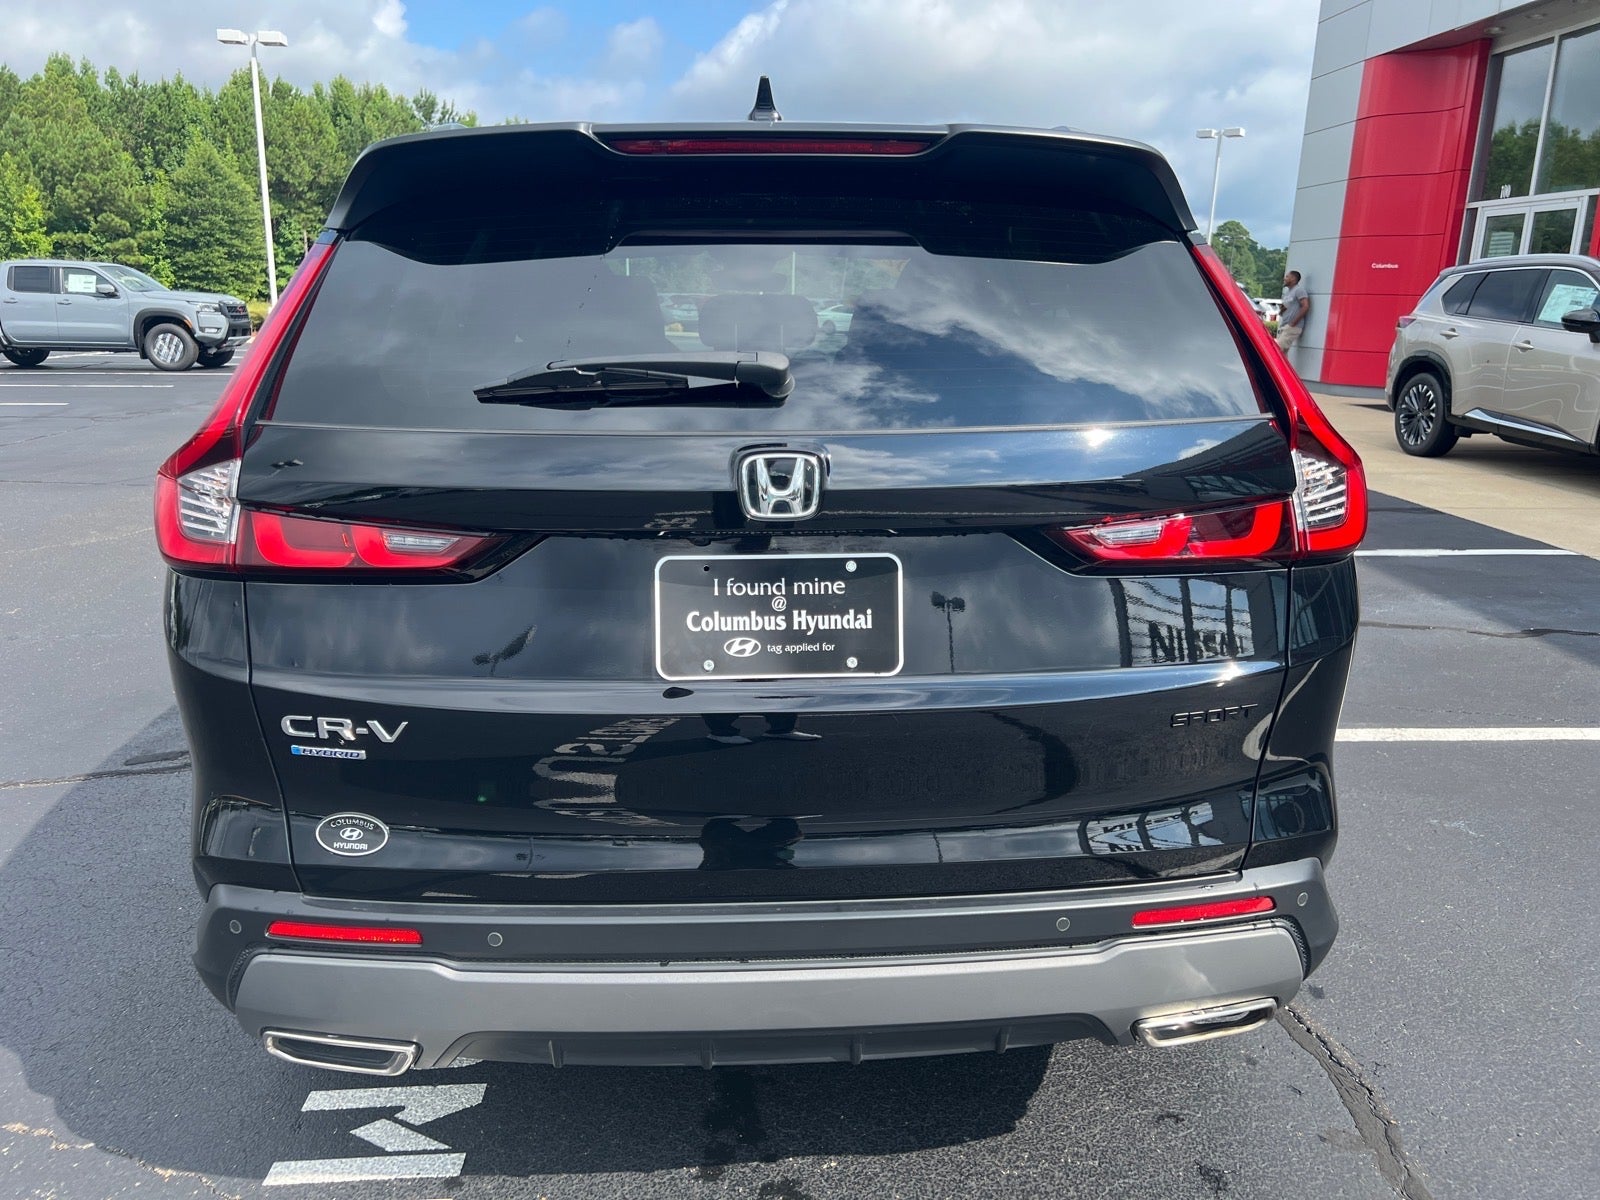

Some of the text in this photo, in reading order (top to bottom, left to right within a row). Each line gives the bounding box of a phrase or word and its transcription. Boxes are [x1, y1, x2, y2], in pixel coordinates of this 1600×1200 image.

[713, 577, 846, 596] I found mine
[771, 595, 787, 612] @
[686, 609, 873, 635] Columbus Hyundai
[767, 642, 836, 654] tag applied for
[1170, 703, 1259, 728] SPORT
[280, 715, 409, 743] CR-V
[302, 748, 361, 759] HYBRID
[330, 818, 375, 831] COLUMBUS
[333, 842, 368, 850] HYUNDAI
